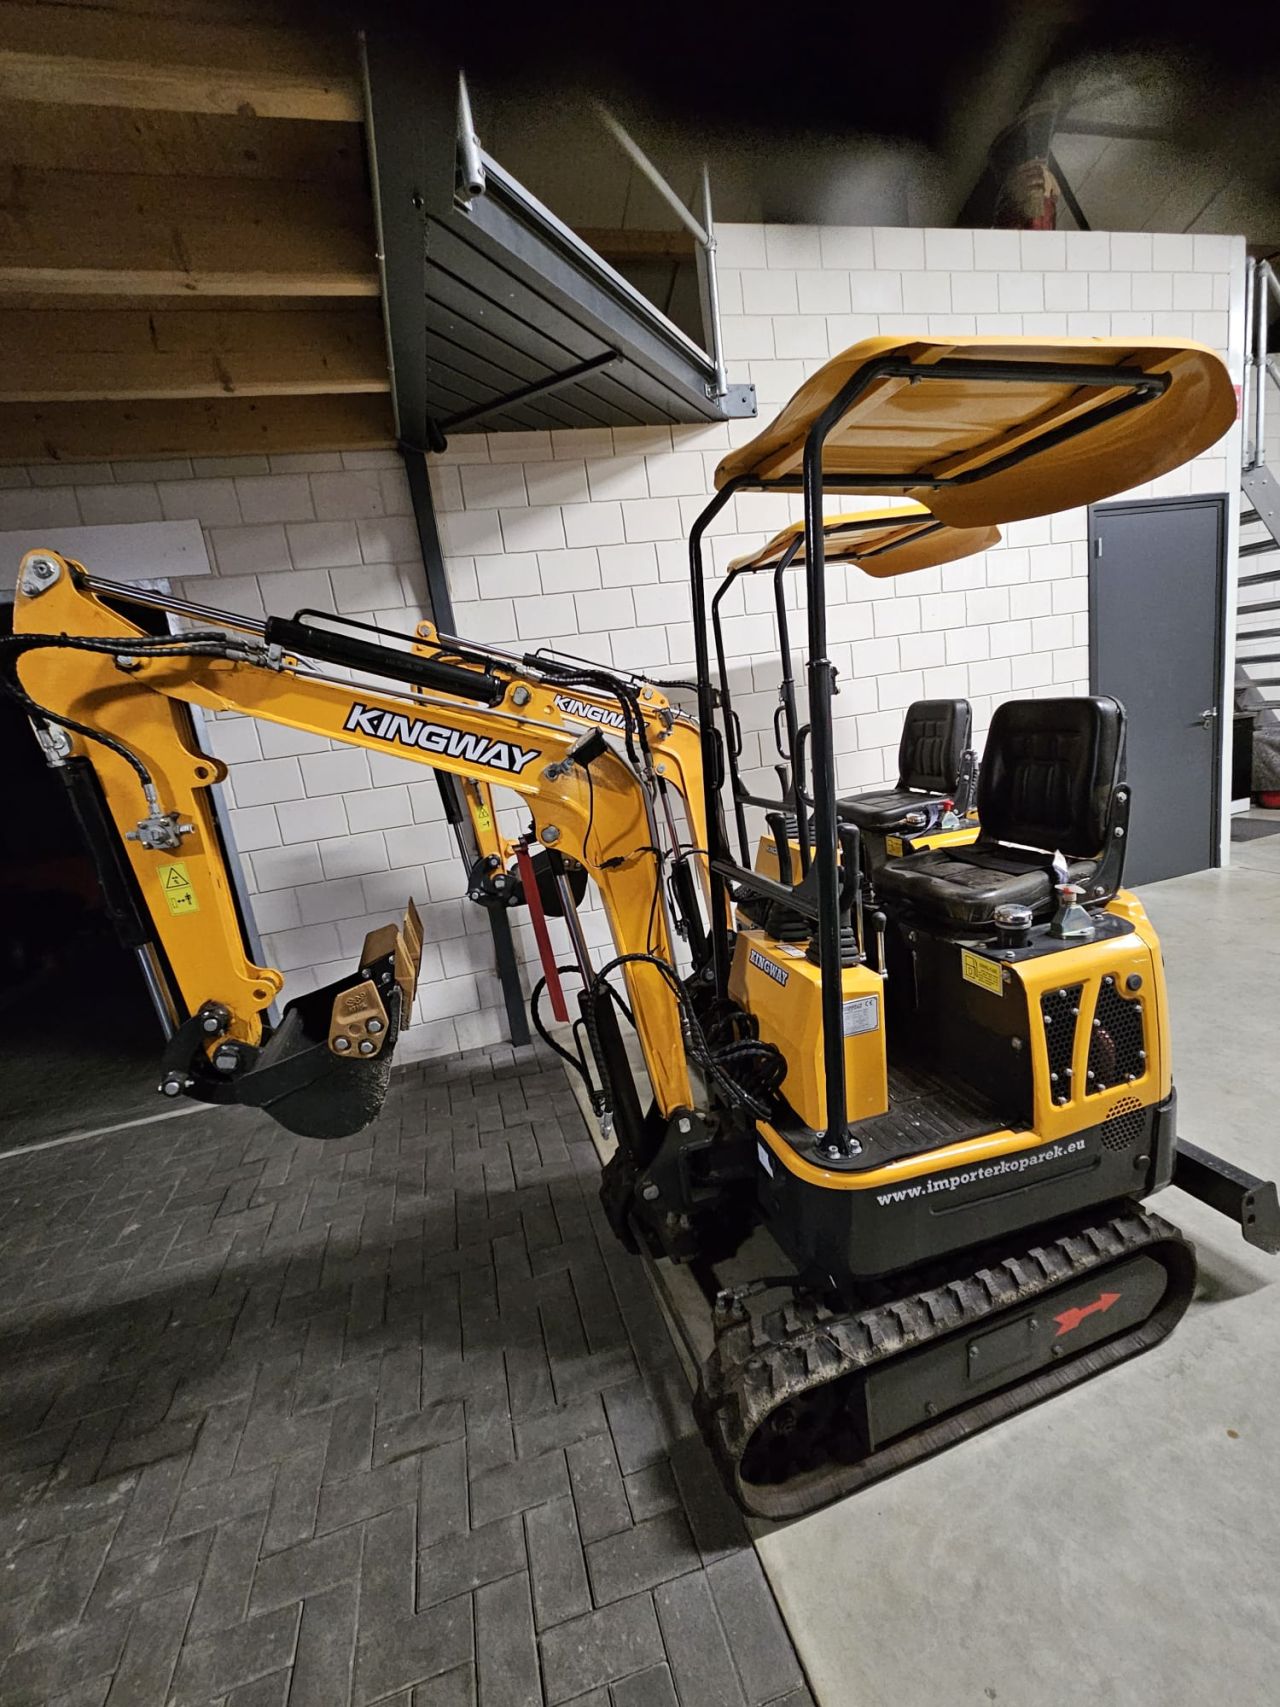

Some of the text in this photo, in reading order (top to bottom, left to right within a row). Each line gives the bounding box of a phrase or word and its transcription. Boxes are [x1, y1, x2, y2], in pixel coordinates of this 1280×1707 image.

[344, 703, 541, 773] KINGWAY
[750, 949, 788, 986] KINGWAY
[877, 1139, 1085, 1206] www.importerkoparek.eu
